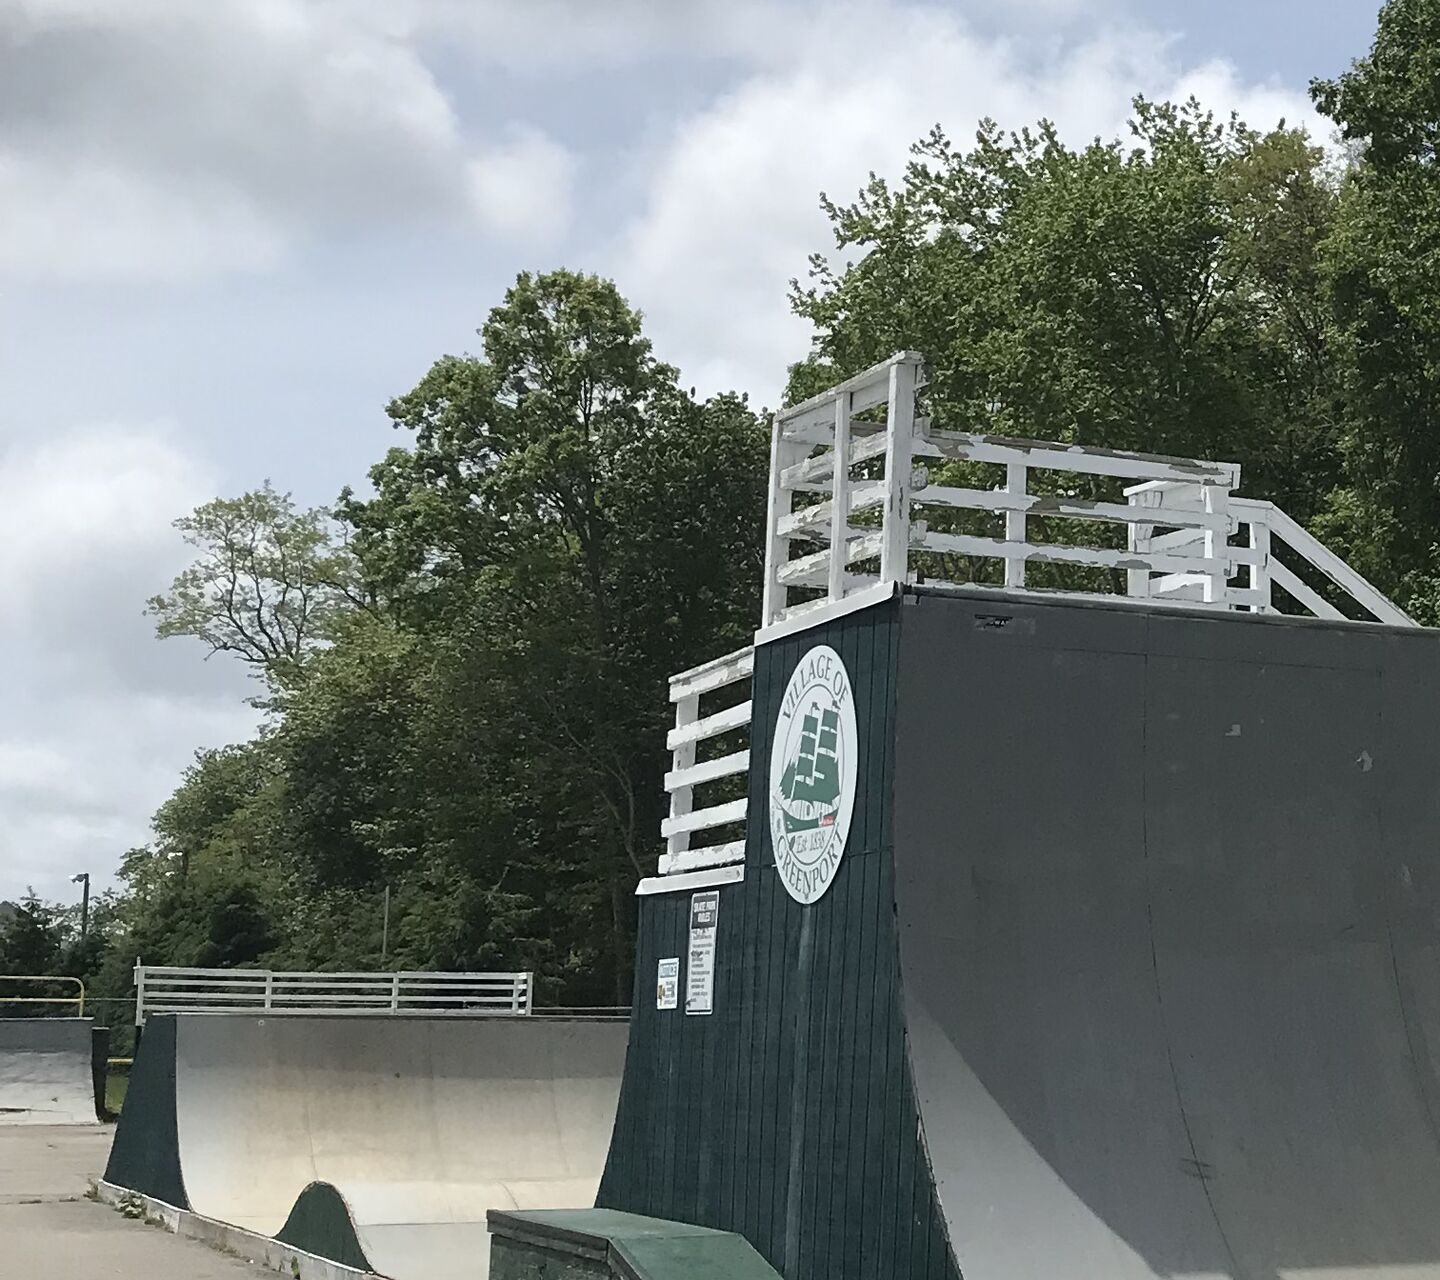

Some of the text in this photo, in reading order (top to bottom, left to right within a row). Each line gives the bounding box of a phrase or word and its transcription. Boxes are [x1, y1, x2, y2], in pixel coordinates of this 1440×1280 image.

[783, 655, 848, 719] VILLAGE OF
[778, 823, 843, 894] GREENPORT
